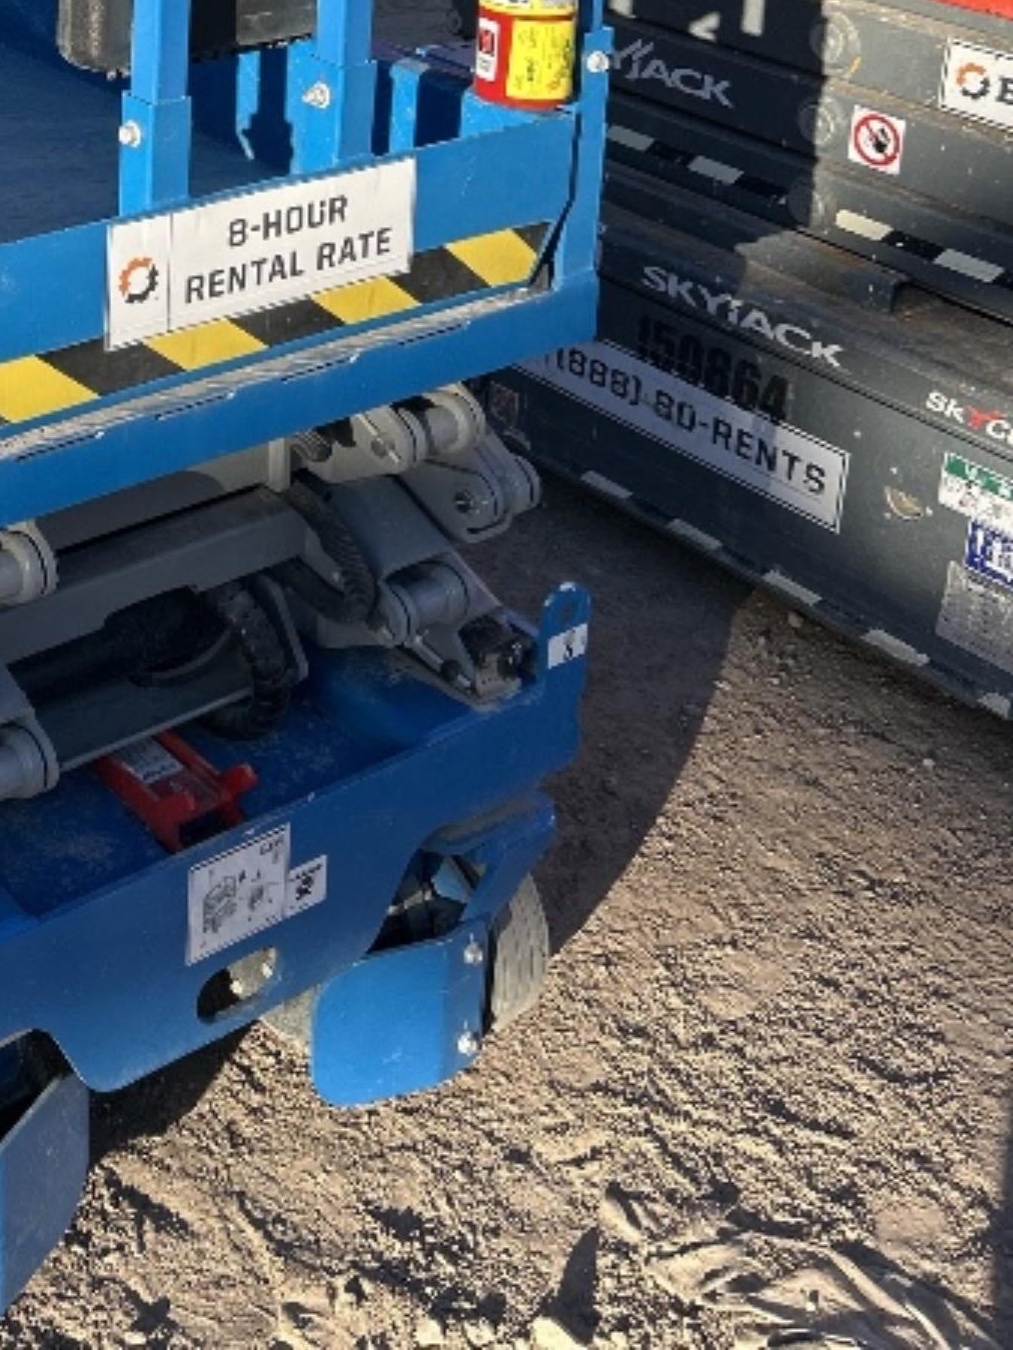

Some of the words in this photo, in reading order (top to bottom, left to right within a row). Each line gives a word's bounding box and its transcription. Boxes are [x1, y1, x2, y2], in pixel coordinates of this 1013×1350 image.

[228, 194, 348, 247] 8-HOUR
[185, 251, 305, 304] RENTAL
[316, 227, 392, 271] RATE
[642, 265, 844, 368] SKYJACK
